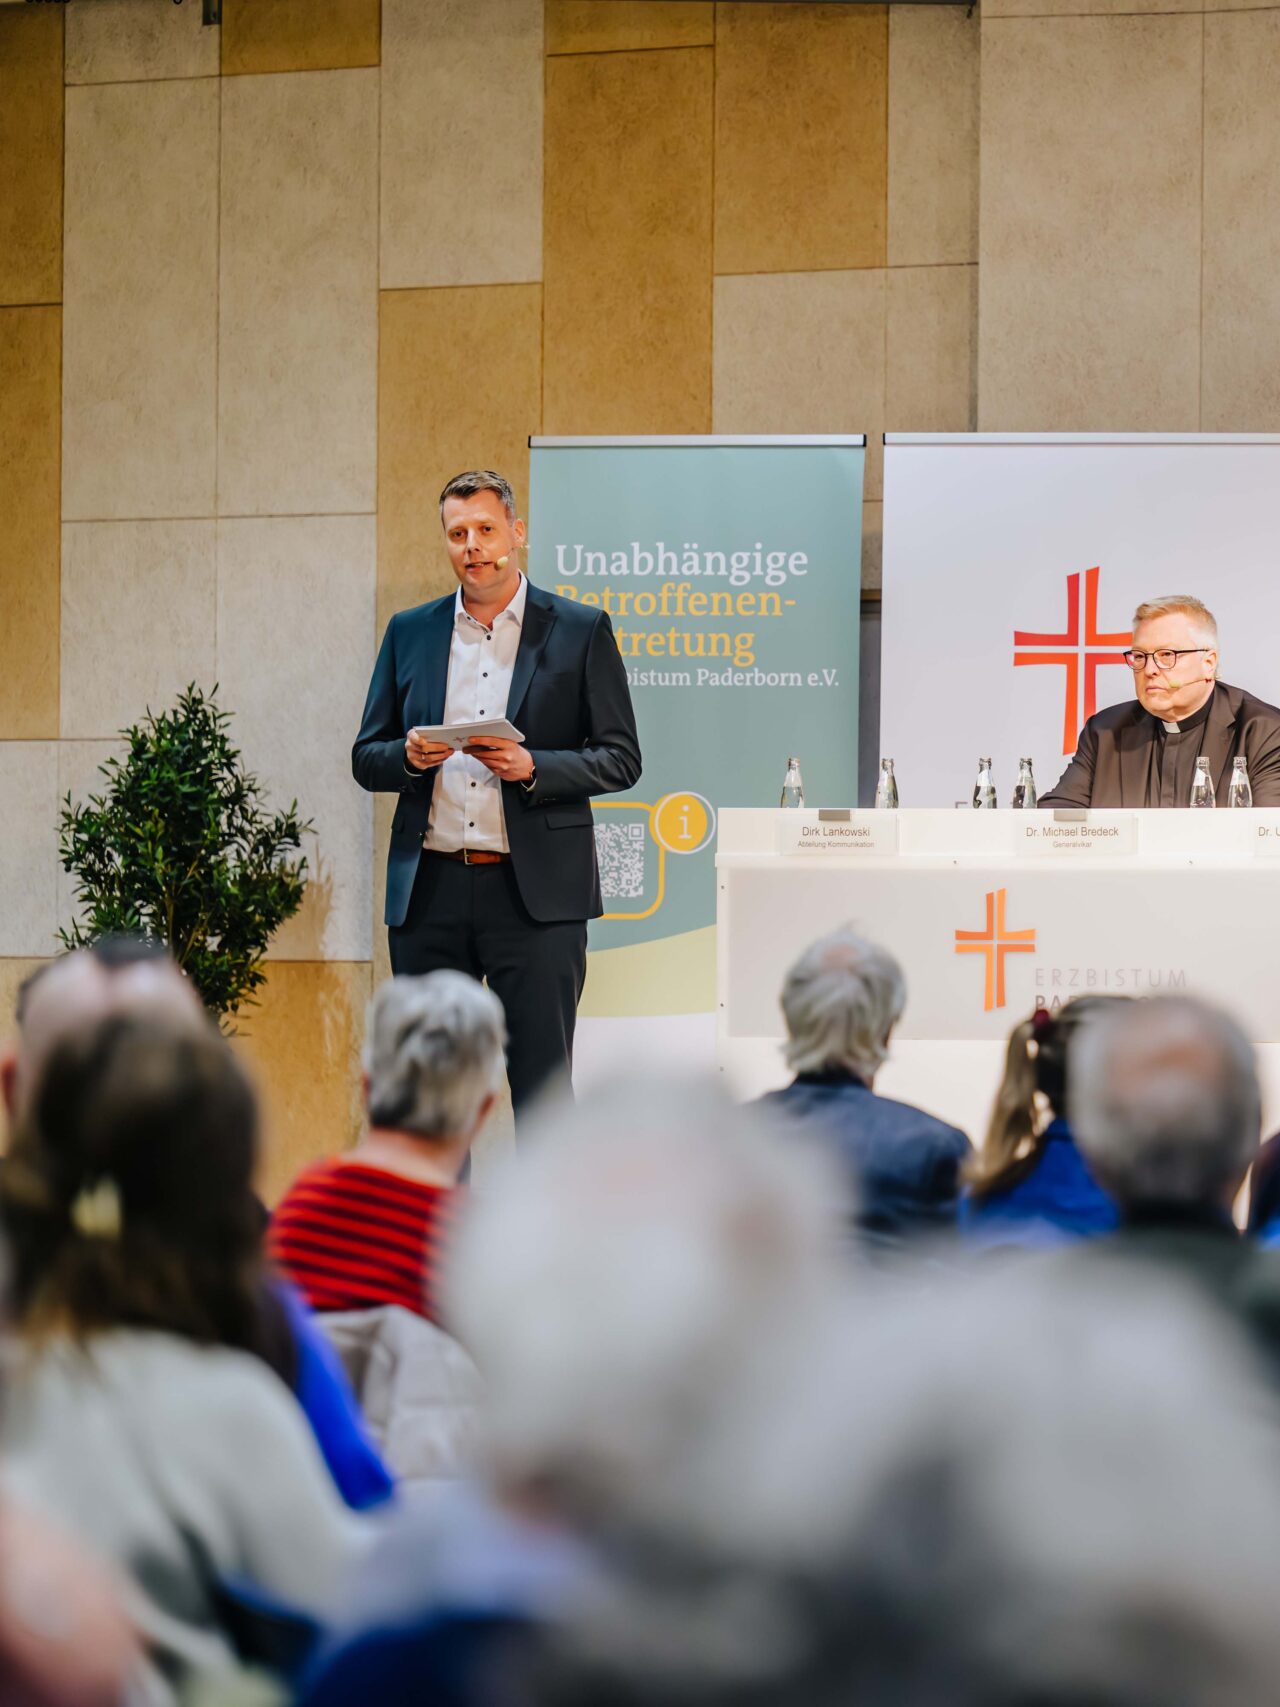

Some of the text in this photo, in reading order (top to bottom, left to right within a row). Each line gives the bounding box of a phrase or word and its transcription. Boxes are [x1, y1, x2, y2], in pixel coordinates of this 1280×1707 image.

[555, 542, 809, 586] Unabhängige
[616, 626, 756, 668] tretung
[696, 668, 803, 687] Paderborn
[807, 669, 840, 687] e.V.
[802, 826, 870, 837] Dirk Lankowski
[1026, 826, 1119, 837] Dr. Michael Bredeck
[1258, 826, 1273, 837] Dr.
[1035, 968, 1187, 988] ERZBISTUM
